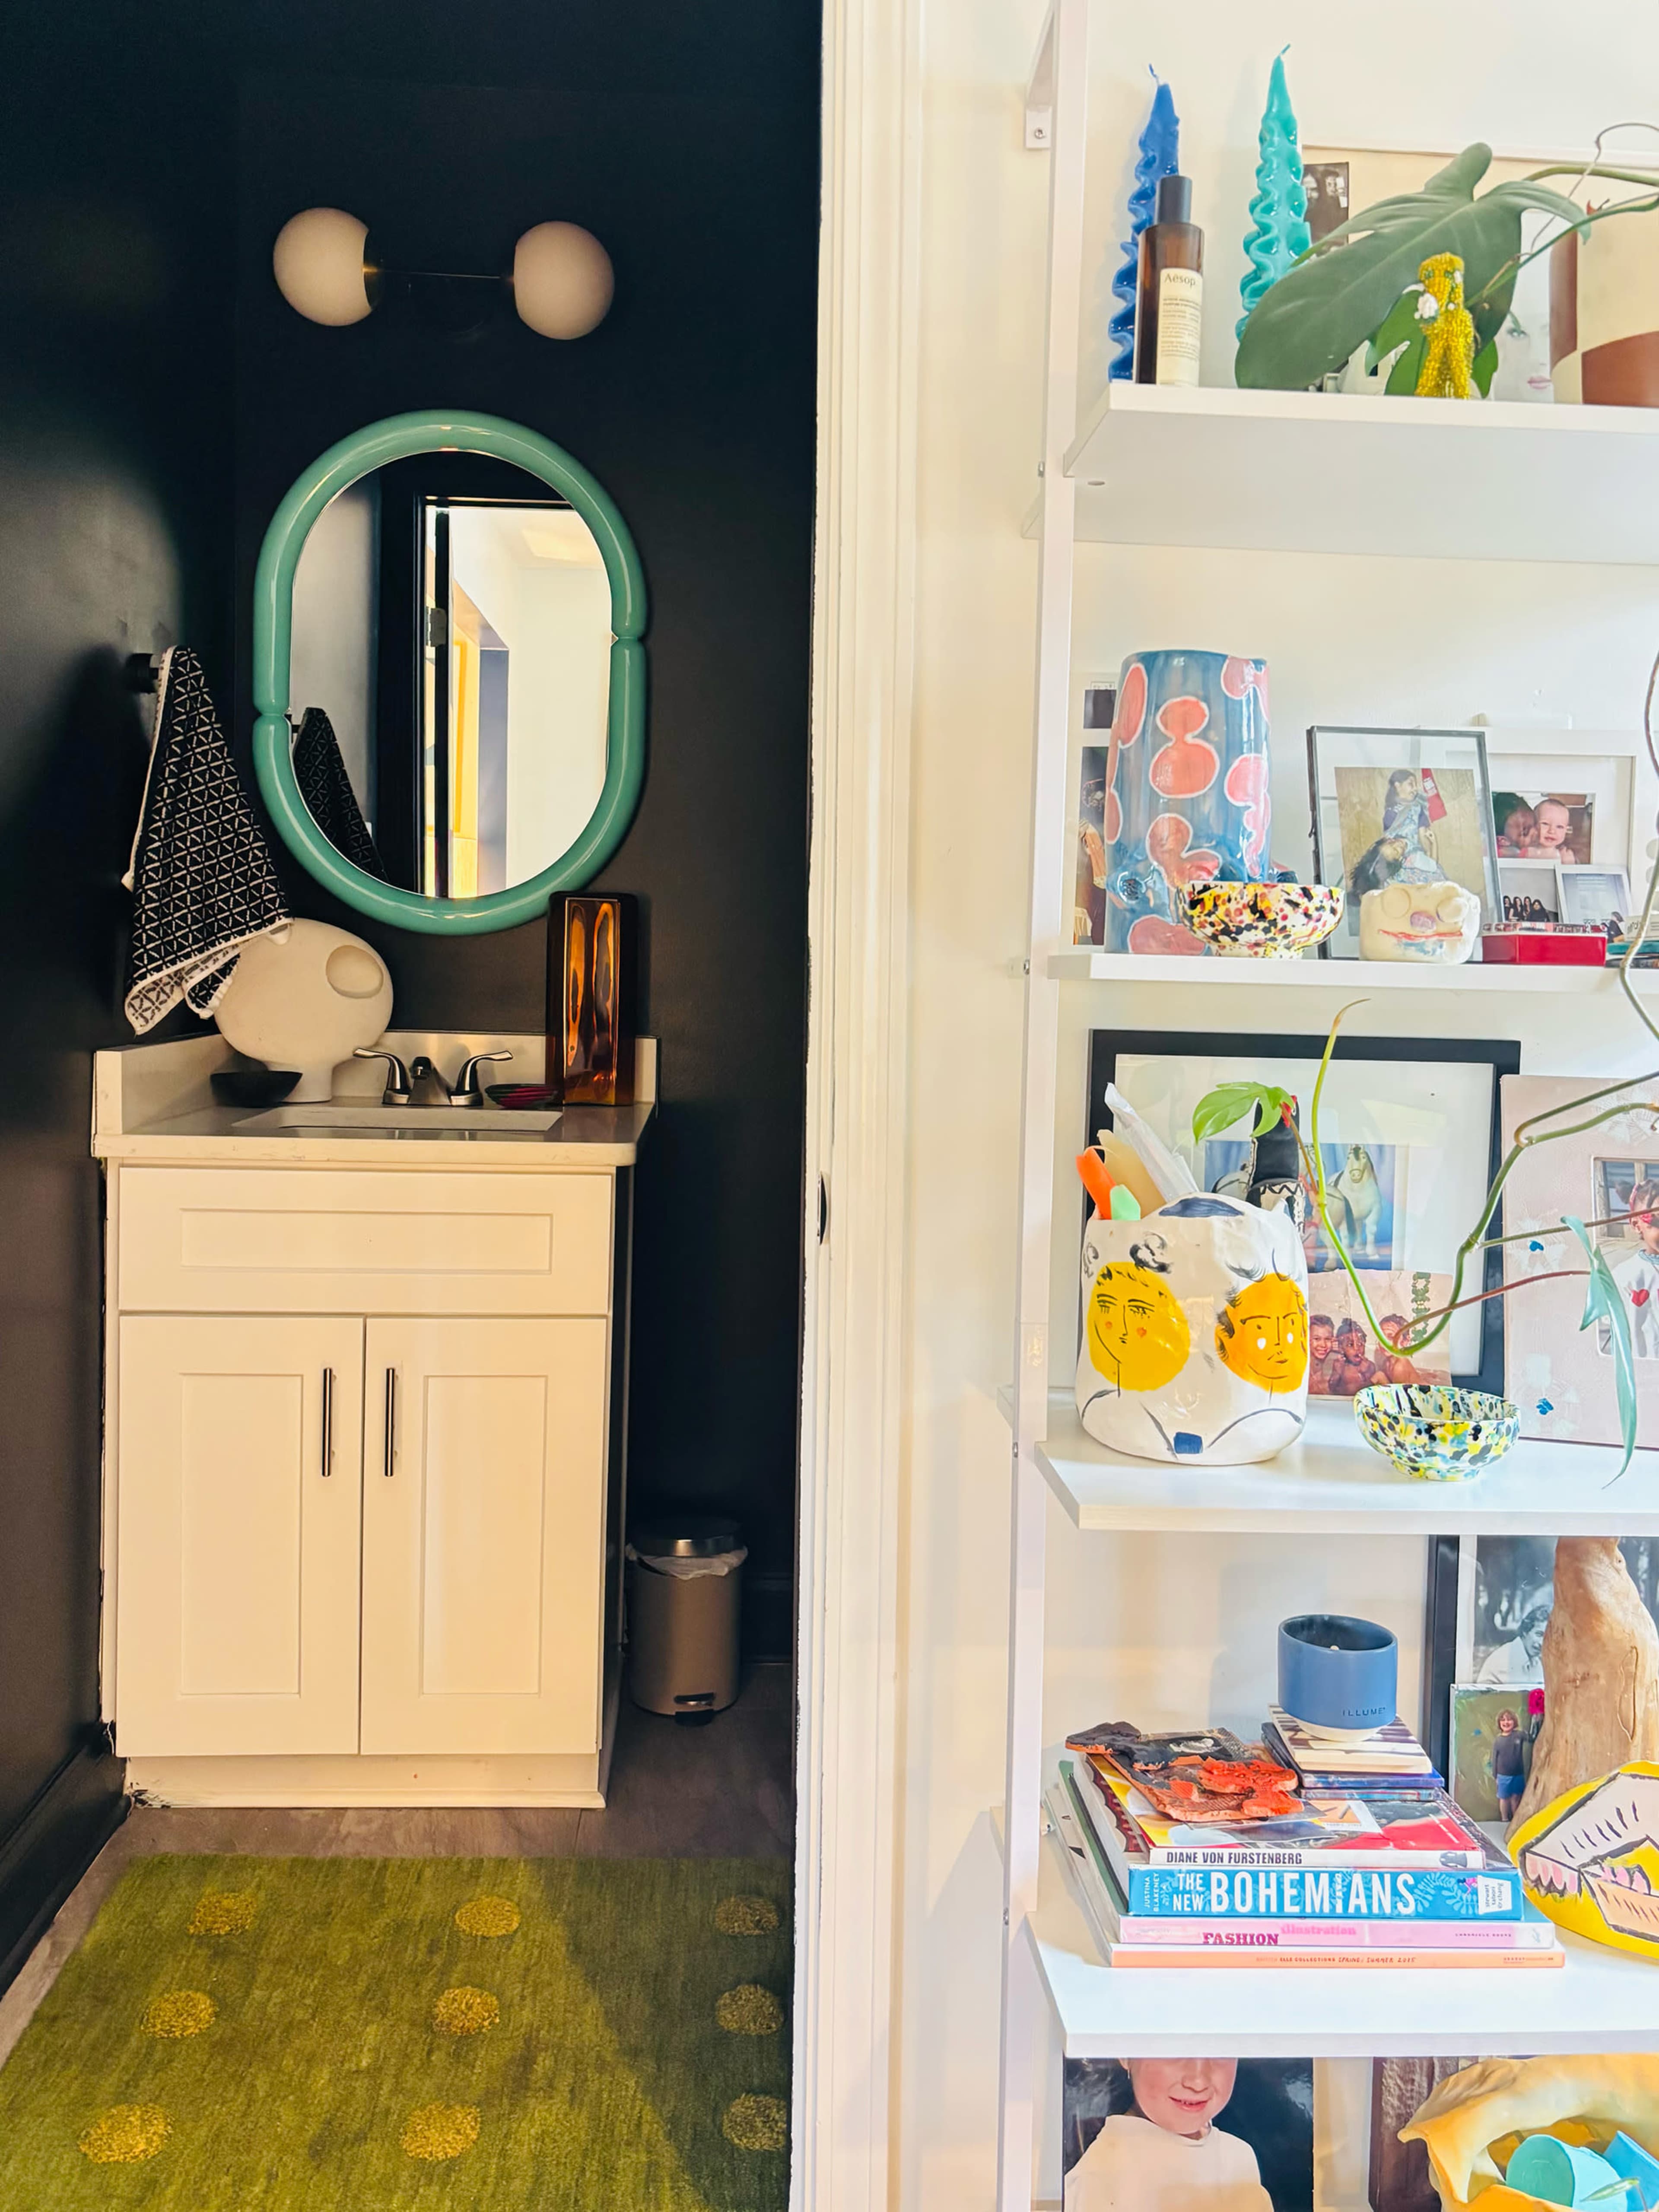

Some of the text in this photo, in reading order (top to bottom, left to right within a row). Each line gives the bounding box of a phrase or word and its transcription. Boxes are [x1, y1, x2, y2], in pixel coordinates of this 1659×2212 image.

[1167, 1852, 1302, 1864] DIANE VON FURSTENBERG
[1177, 1873, 1206, 1891] THE
[1211, 1871, 1415, 1914] BOHEMIANS
[1173, 1894, 1203, 1911] NEW
[1281, 1923, 1356, 1935] illustration
[1202, 1933, 1278, 1945] FASHION
